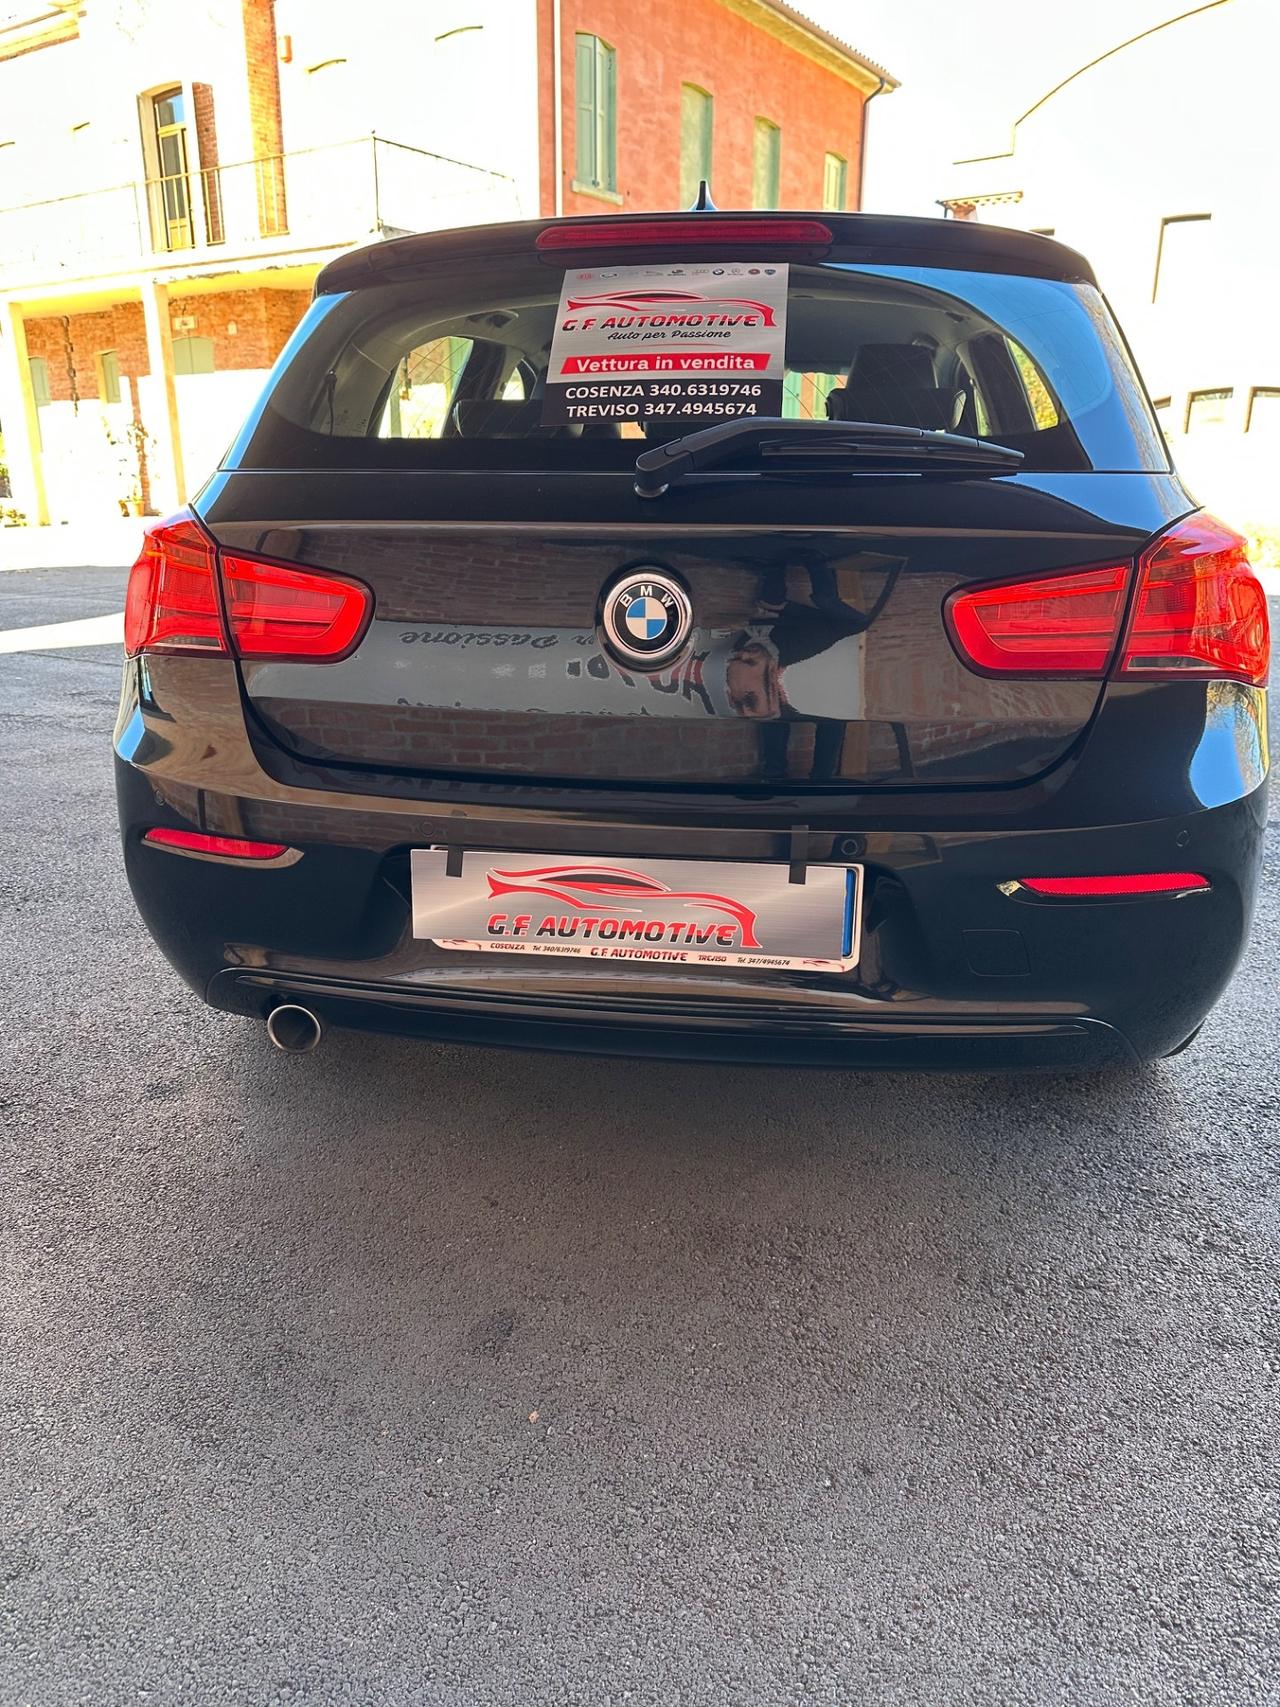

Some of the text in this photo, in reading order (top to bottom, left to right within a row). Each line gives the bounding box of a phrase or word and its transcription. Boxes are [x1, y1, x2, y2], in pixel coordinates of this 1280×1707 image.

[600, 314, 760, 330] AUTOMOTIVE
[608, 329, 732, 341] Auto per Passione
[577, 355, 755, 372] Vettura in vendita
[565, 384, 762, 399] COSENZA 340.6319746
[566, 402, 757, 418] TREVISO 347.4945674
[619, 585, 675, 609] BMW
[535, 915, 738, 947] AUTOMOTIVE
[490, 943, 526, 951] COSENZA
[611, 948, 688, 961] AUTOMOTIVE
